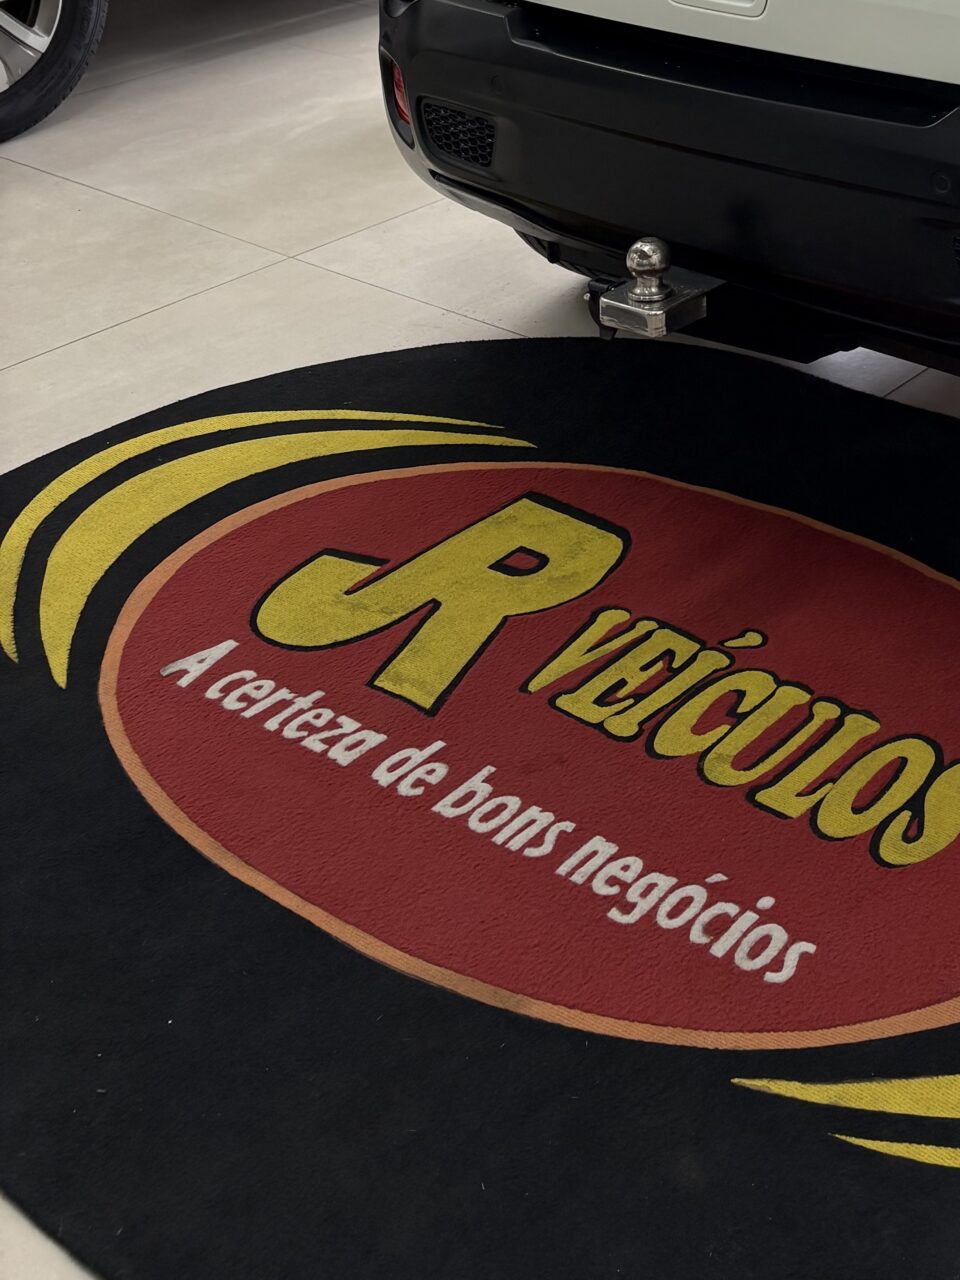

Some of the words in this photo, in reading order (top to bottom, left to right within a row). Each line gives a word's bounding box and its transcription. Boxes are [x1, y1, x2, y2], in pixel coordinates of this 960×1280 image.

[250, 491, 631, 717] JR
[159, 638, 241, 688] A
[204, 664, 381, 767] certeza
[371, 740, 447, 798] de
[434, 766, 576, 859] bons
[555, 834, 818, 985] negócios
